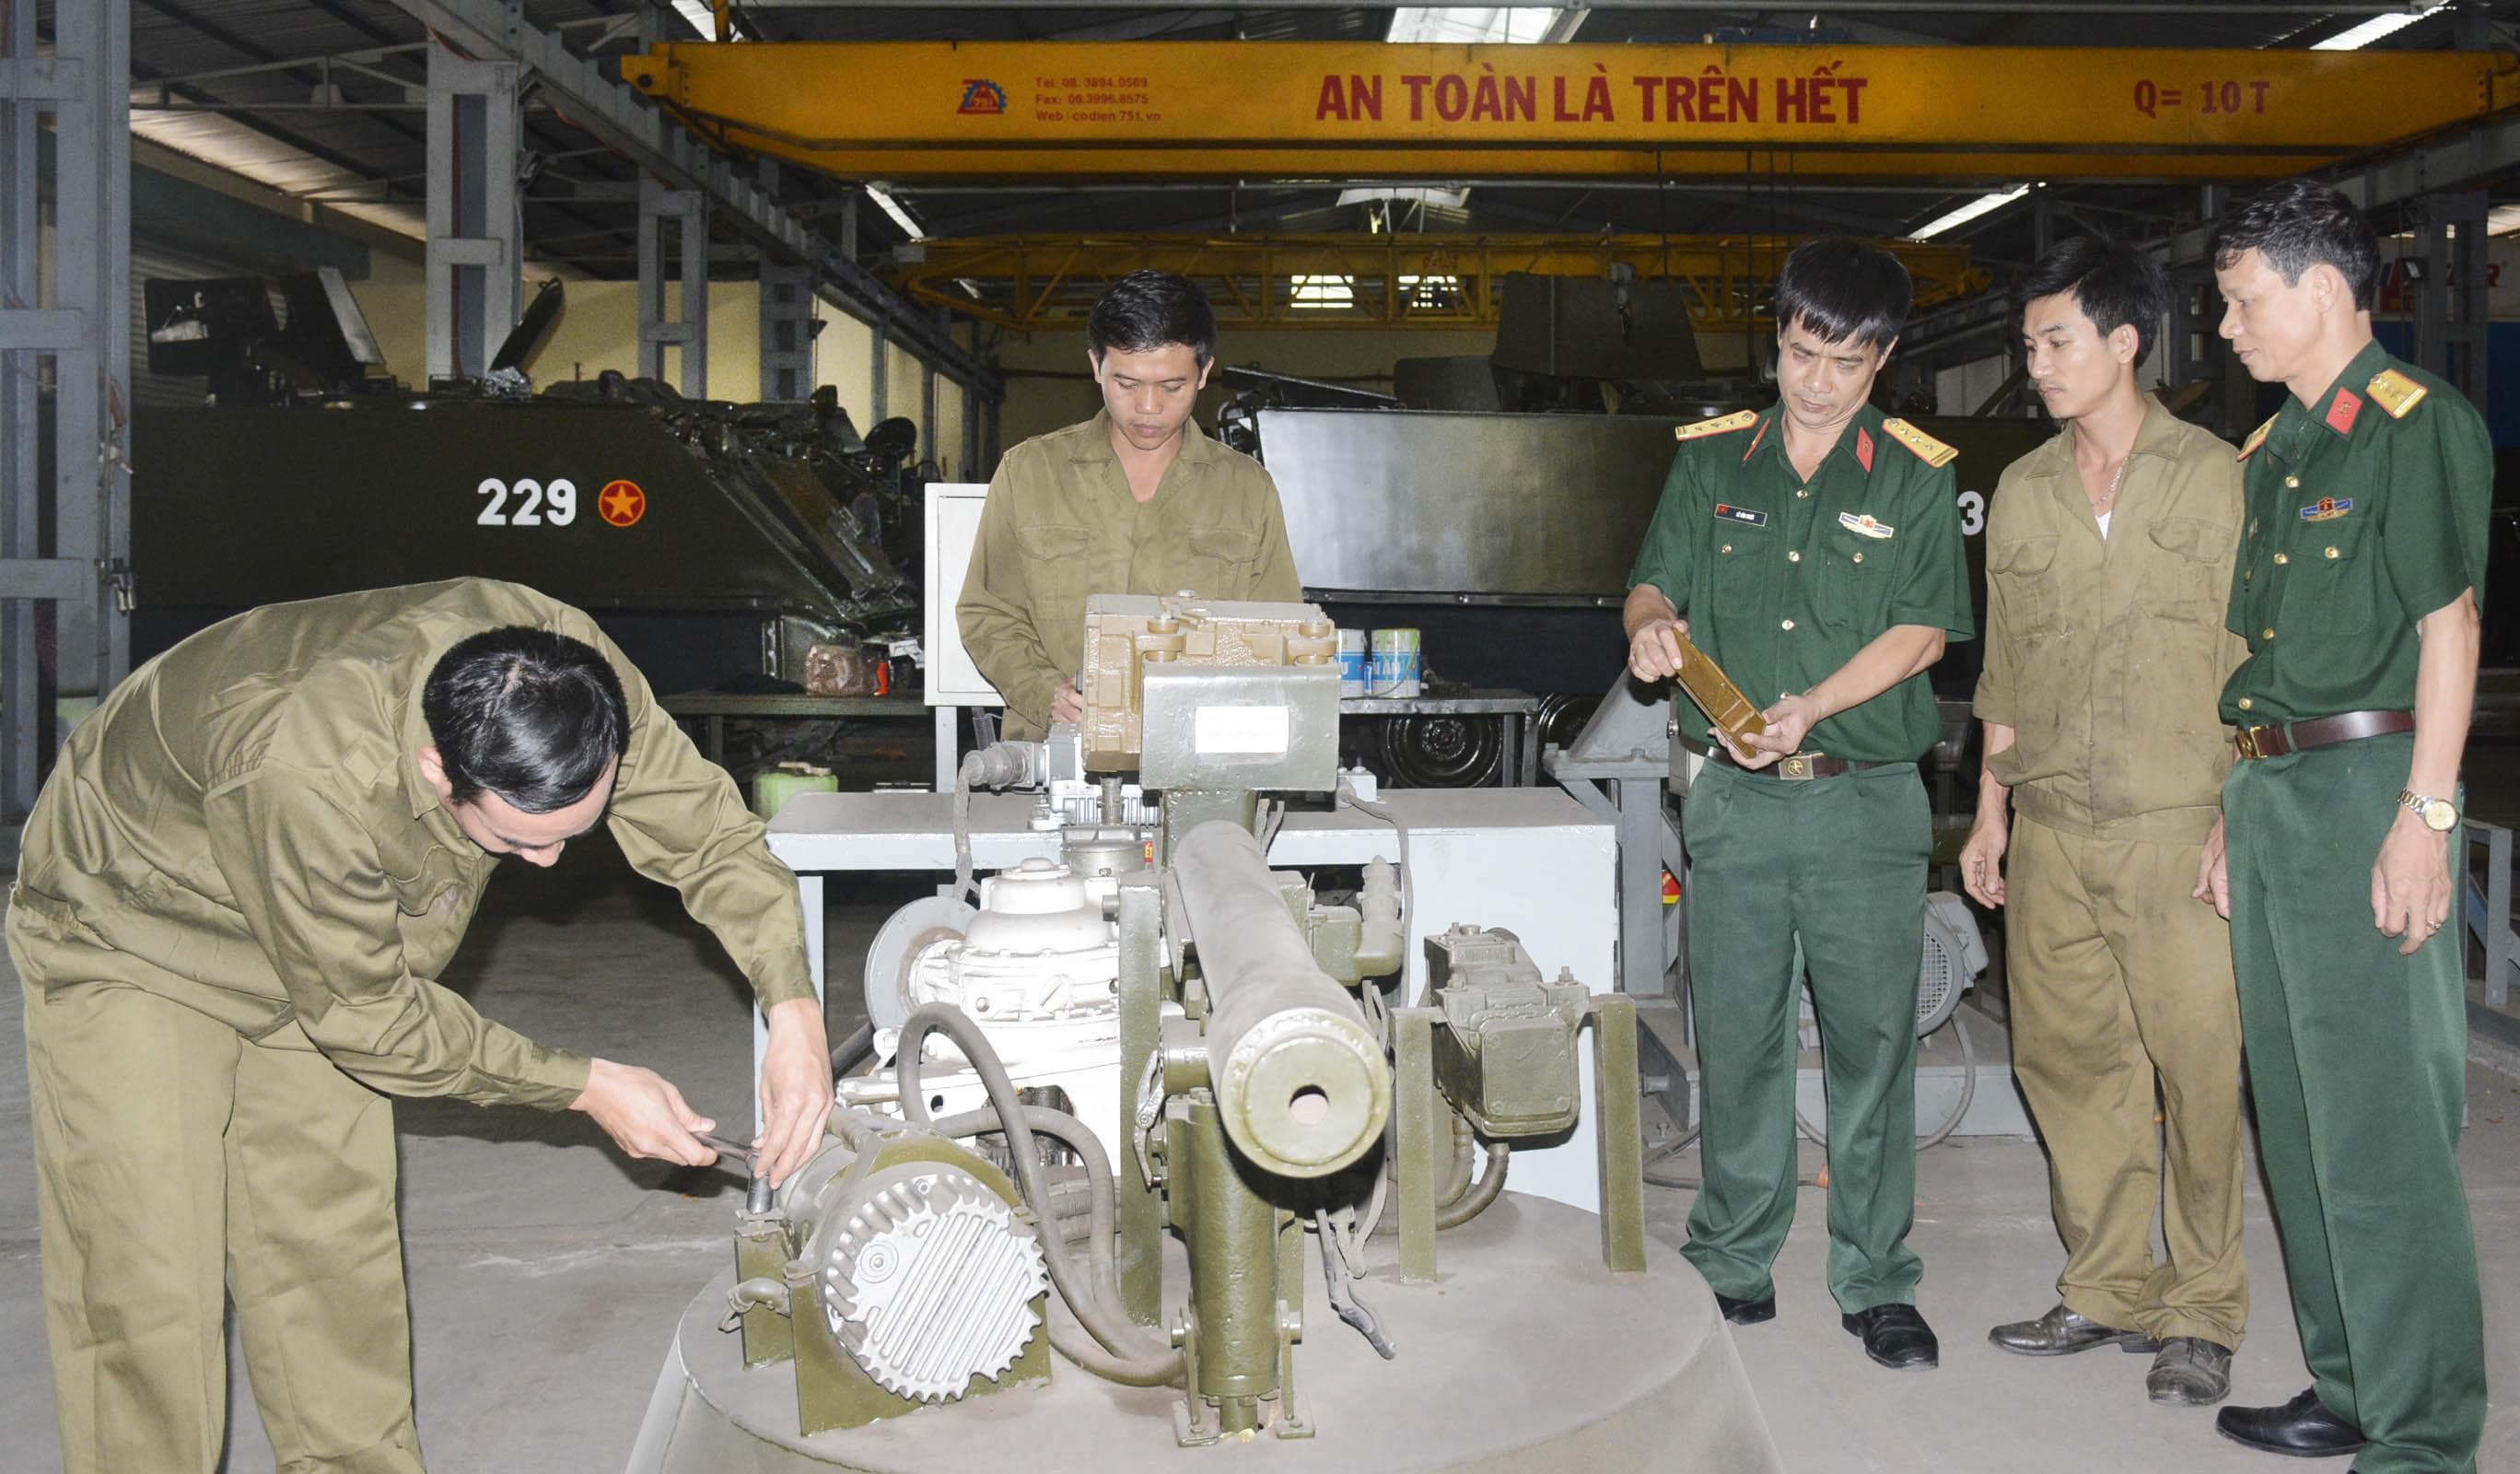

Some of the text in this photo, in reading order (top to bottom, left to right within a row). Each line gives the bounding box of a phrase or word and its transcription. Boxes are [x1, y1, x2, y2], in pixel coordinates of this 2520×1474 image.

[1315, 60, 1868, 123] AN TOÀN LÀ TRÊN HẾT
[477, 477, 577, 526] 229
[1957, 490, 1985, 536] 3
